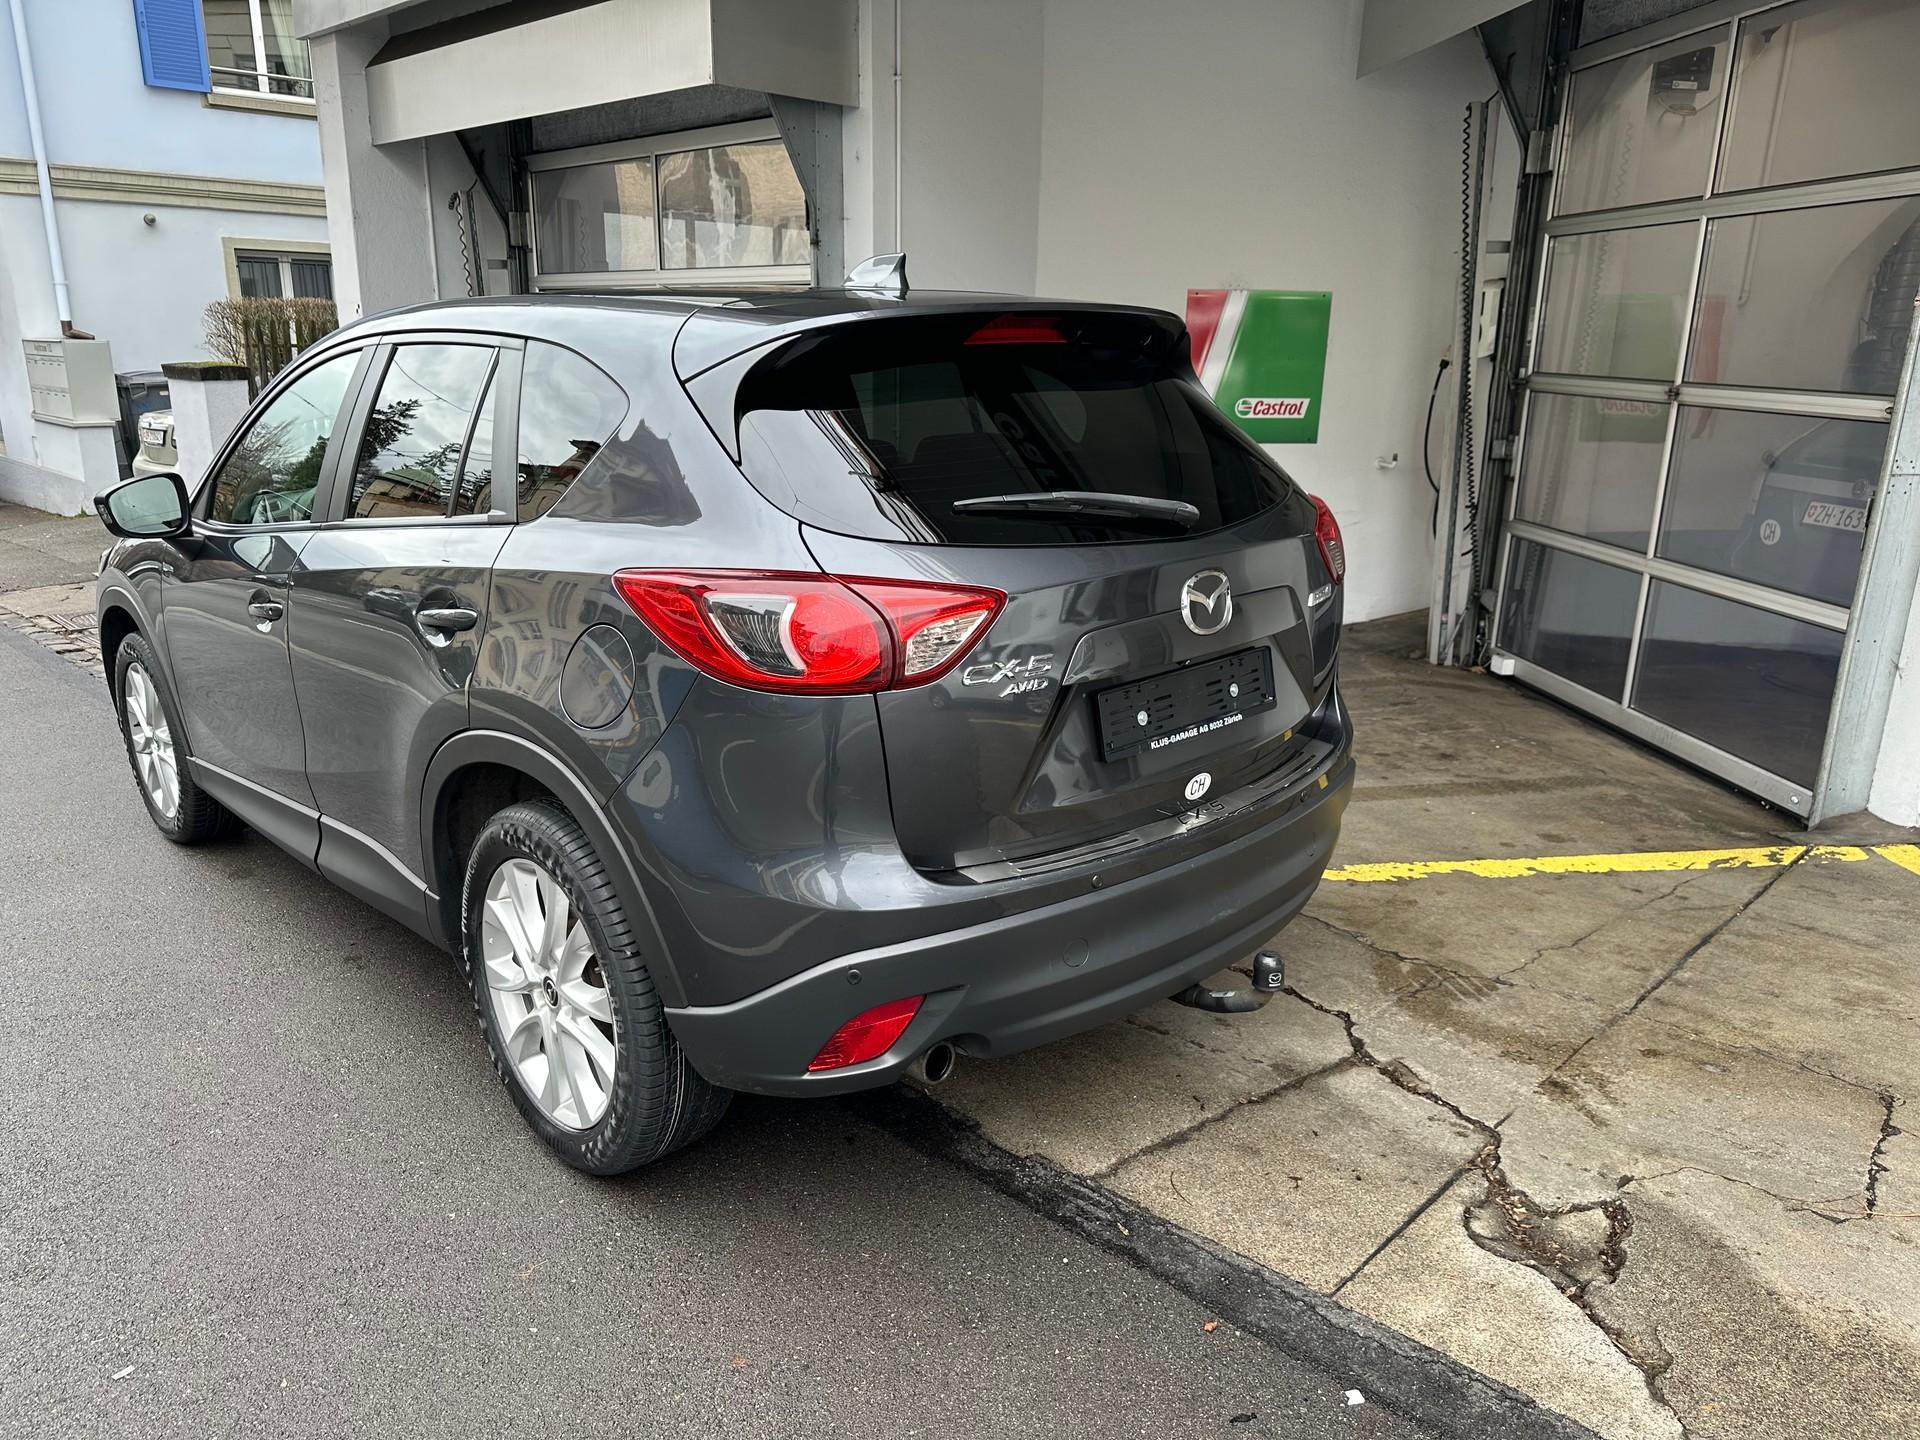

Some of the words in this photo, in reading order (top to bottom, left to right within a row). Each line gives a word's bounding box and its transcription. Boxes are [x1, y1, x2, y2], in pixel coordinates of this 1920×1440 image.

[1252, 400, 1304, 416] Castrol
[1763, 522, 1777, 542] CH
[962, 653, 1054, 686] CX-5
[999, 678, 1049, 698] AWD
[1150, 727, 1198, 749] KLUS-GARAGE
[1199, 724, 1208, 734] AG
[1209, 719, 1223, 731] 8032
[1223, 713, 1243, 726] Zürich
[1190, 776, 1207, 796] CH
[1177, 800, 1226, 825] CX-5
